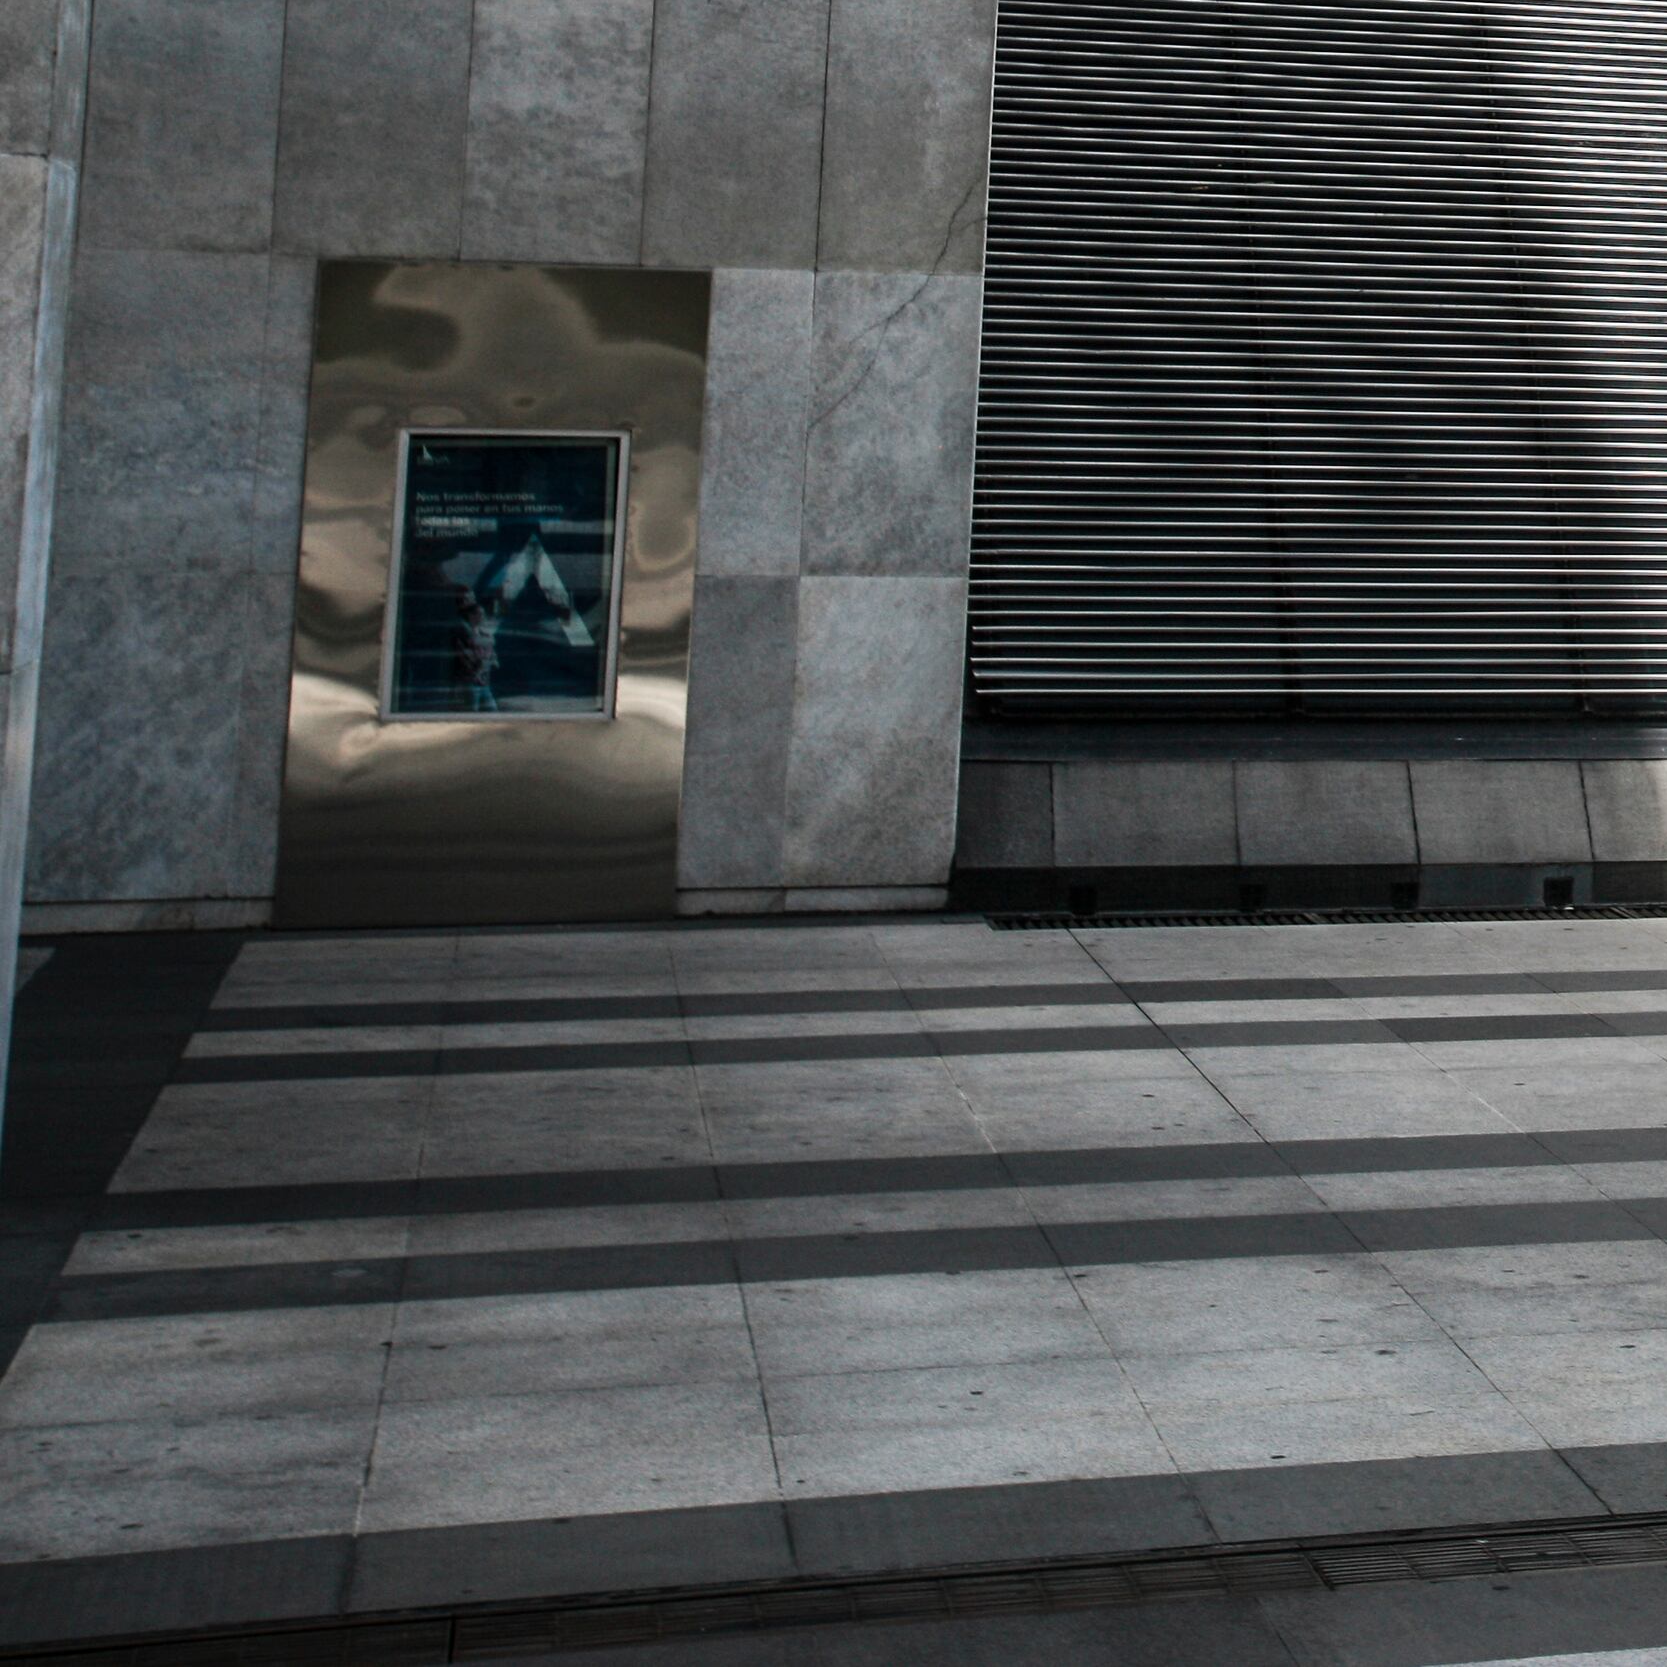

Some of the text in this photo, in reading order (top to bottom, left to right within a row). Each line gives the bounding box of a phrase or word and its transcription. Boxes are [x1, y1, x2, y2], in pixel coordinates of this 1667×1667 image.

[416, 491, 536, 502] Nos transformamos
[416, 506, 442, 516] para
[446, 505, 480, 515] poner
[524, 504, 564, 513] manos
